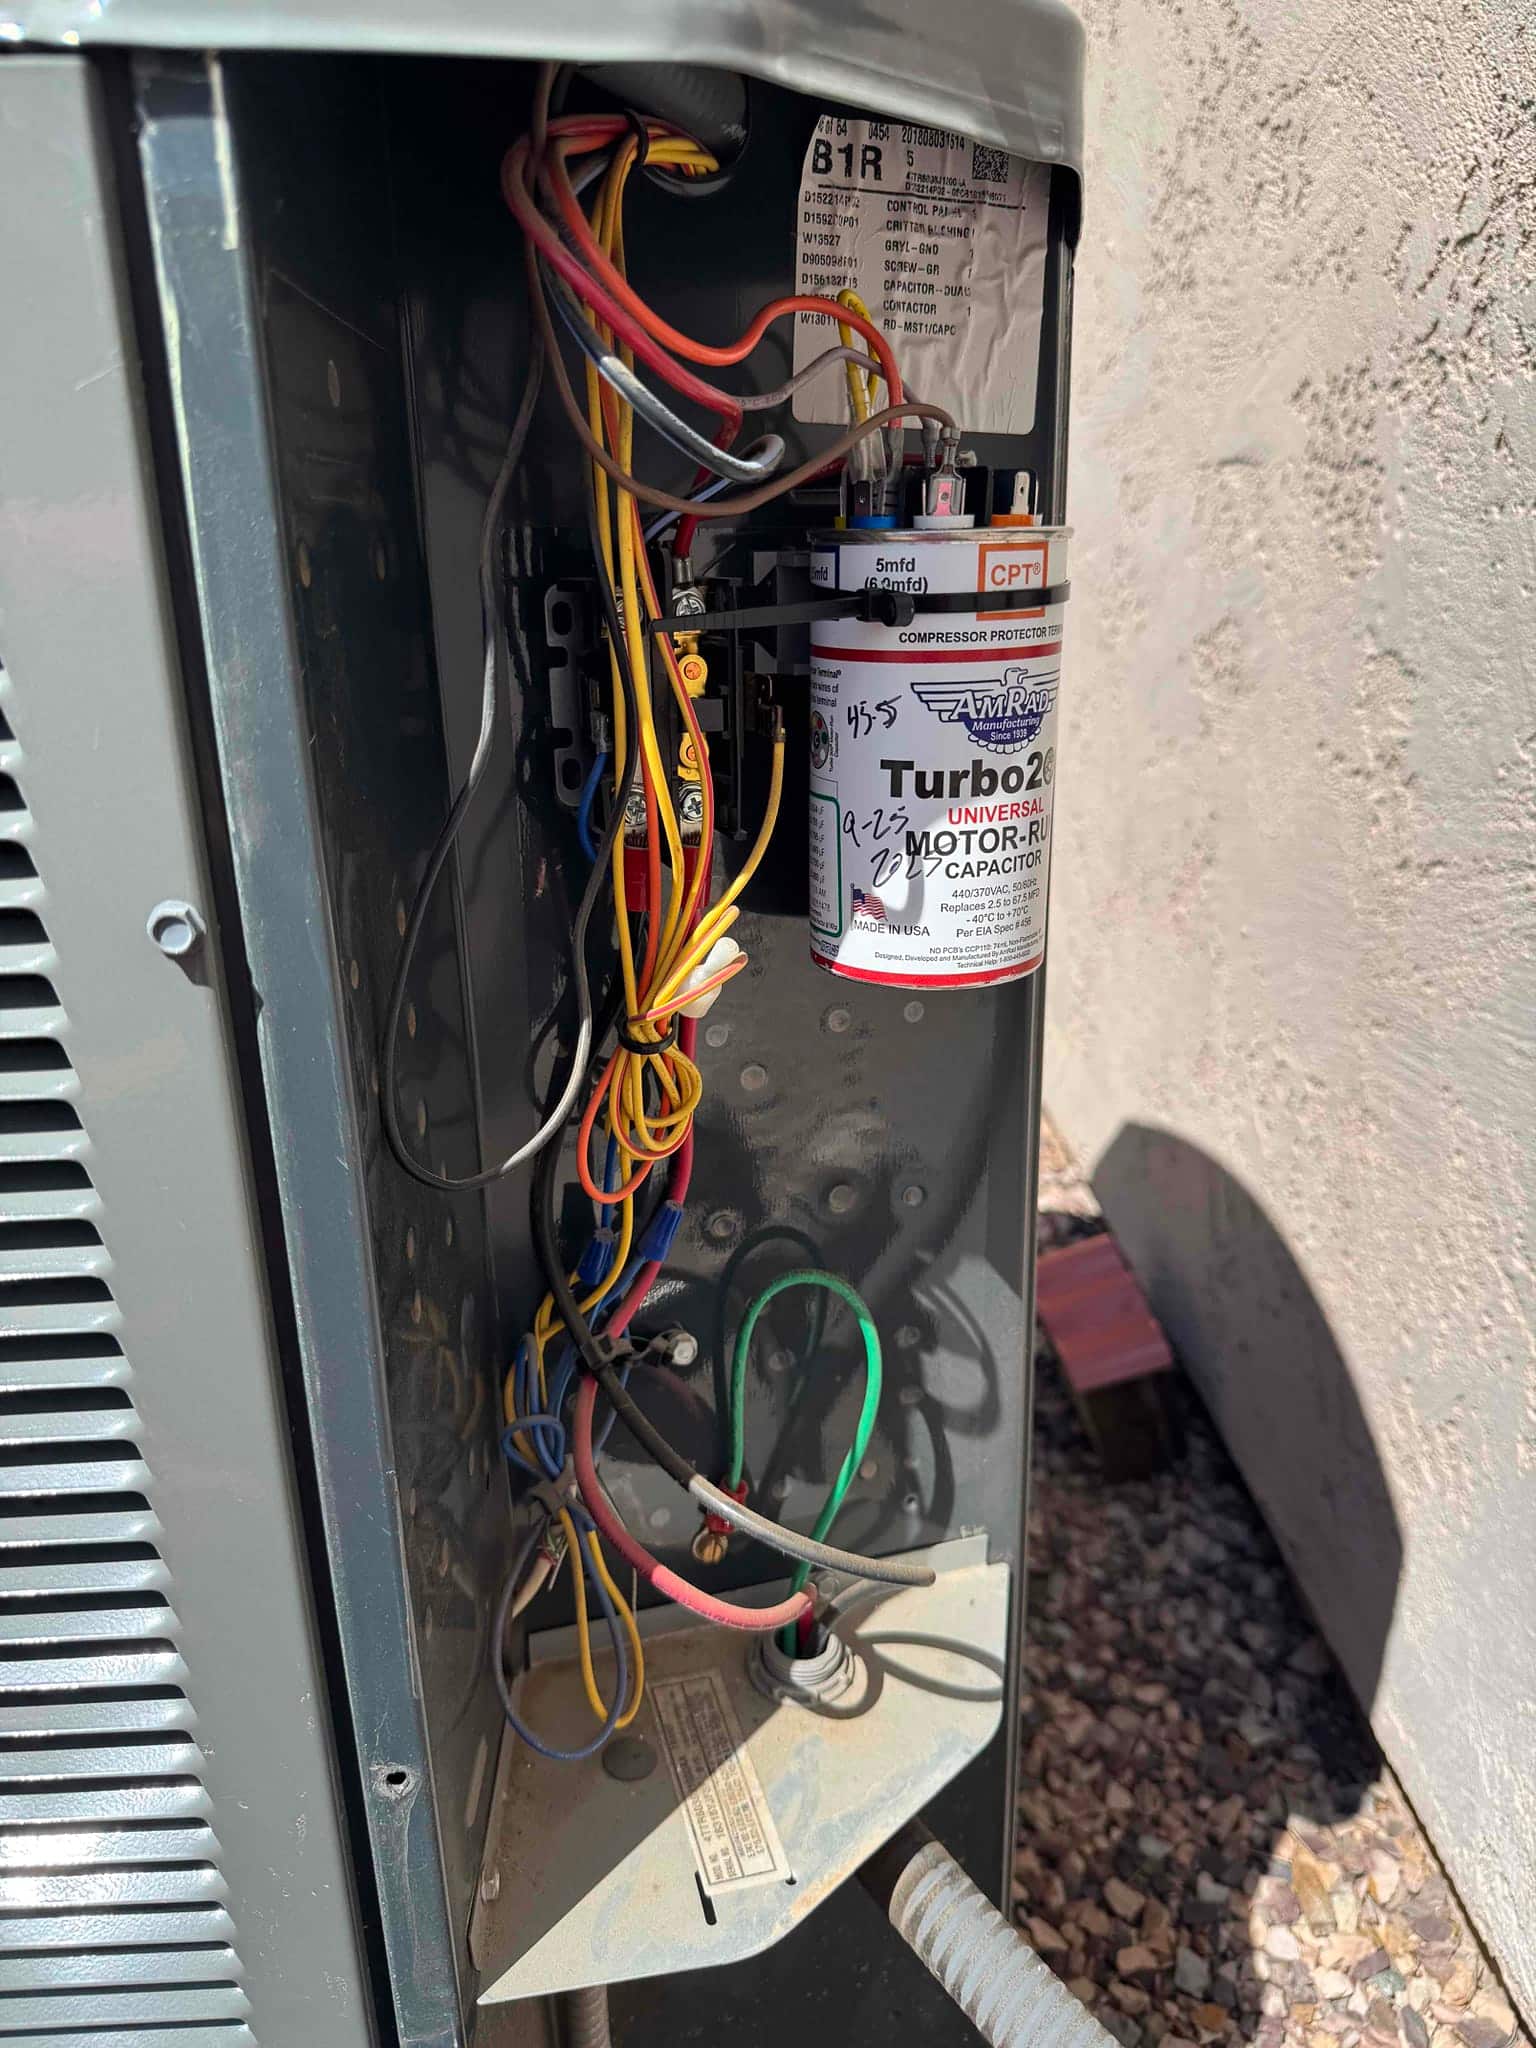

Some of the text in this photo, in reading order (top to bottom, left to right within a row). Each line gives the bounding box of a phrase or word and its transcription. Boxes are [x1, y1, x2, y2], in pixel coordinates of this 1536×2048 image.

[811, 138, 882, 181] B1R
[906, 150, 914, 167] 5
[887, 200, 929, 216] CONTROL
[886, 220, 925, 234] CRITTER
[802, 232, 841, 247] W13527
[885, 239, 939, 256] GRYL-GND
[884, 260, 940, 276] SCREW-GR
[883, 299, 937, 315] CONTACTOR
[876, 557, 916, 573] 5mfd
[990, 561, 1042, 586] CPT®
[898, 630, 988, 645] COMPRESSOR
[990, 626, 1047, 642] PROTECTOR
[971, 715, 1041, 732] Manufacturing
[990, 728, 1028, 742] Since 1939
[948, 796, 1044, 826] UNIVERSAL
[945, 849, 1043, 880] CAPACITOR
[951, 884, 1011, 899] 440/370VAC,
[940, 902, 986, 915] Replaces
[987, 899, 1002, 910] 2.5
[1003, 898, 1011, 908] to
[997, 912, 1005, 921] to
[1006, 904, 1029, 919] +70°C
[853, 919, 885, 935] MADE
[888, 924, 901, 936] IN
[904, 924, 931, 937] USA
[956, 928, 974, 938] Per
[976, 925, 992, 937] EIA
[993, 923, 1014, 935] Spec
[874, 951, 904, 961] Designed,
[905, 954, 938, 963] Developed
[952, 951, 991, 961] Manufactured
[943, 946, 964, 954] PCB's
[957, 960, 984, 969] Technical
